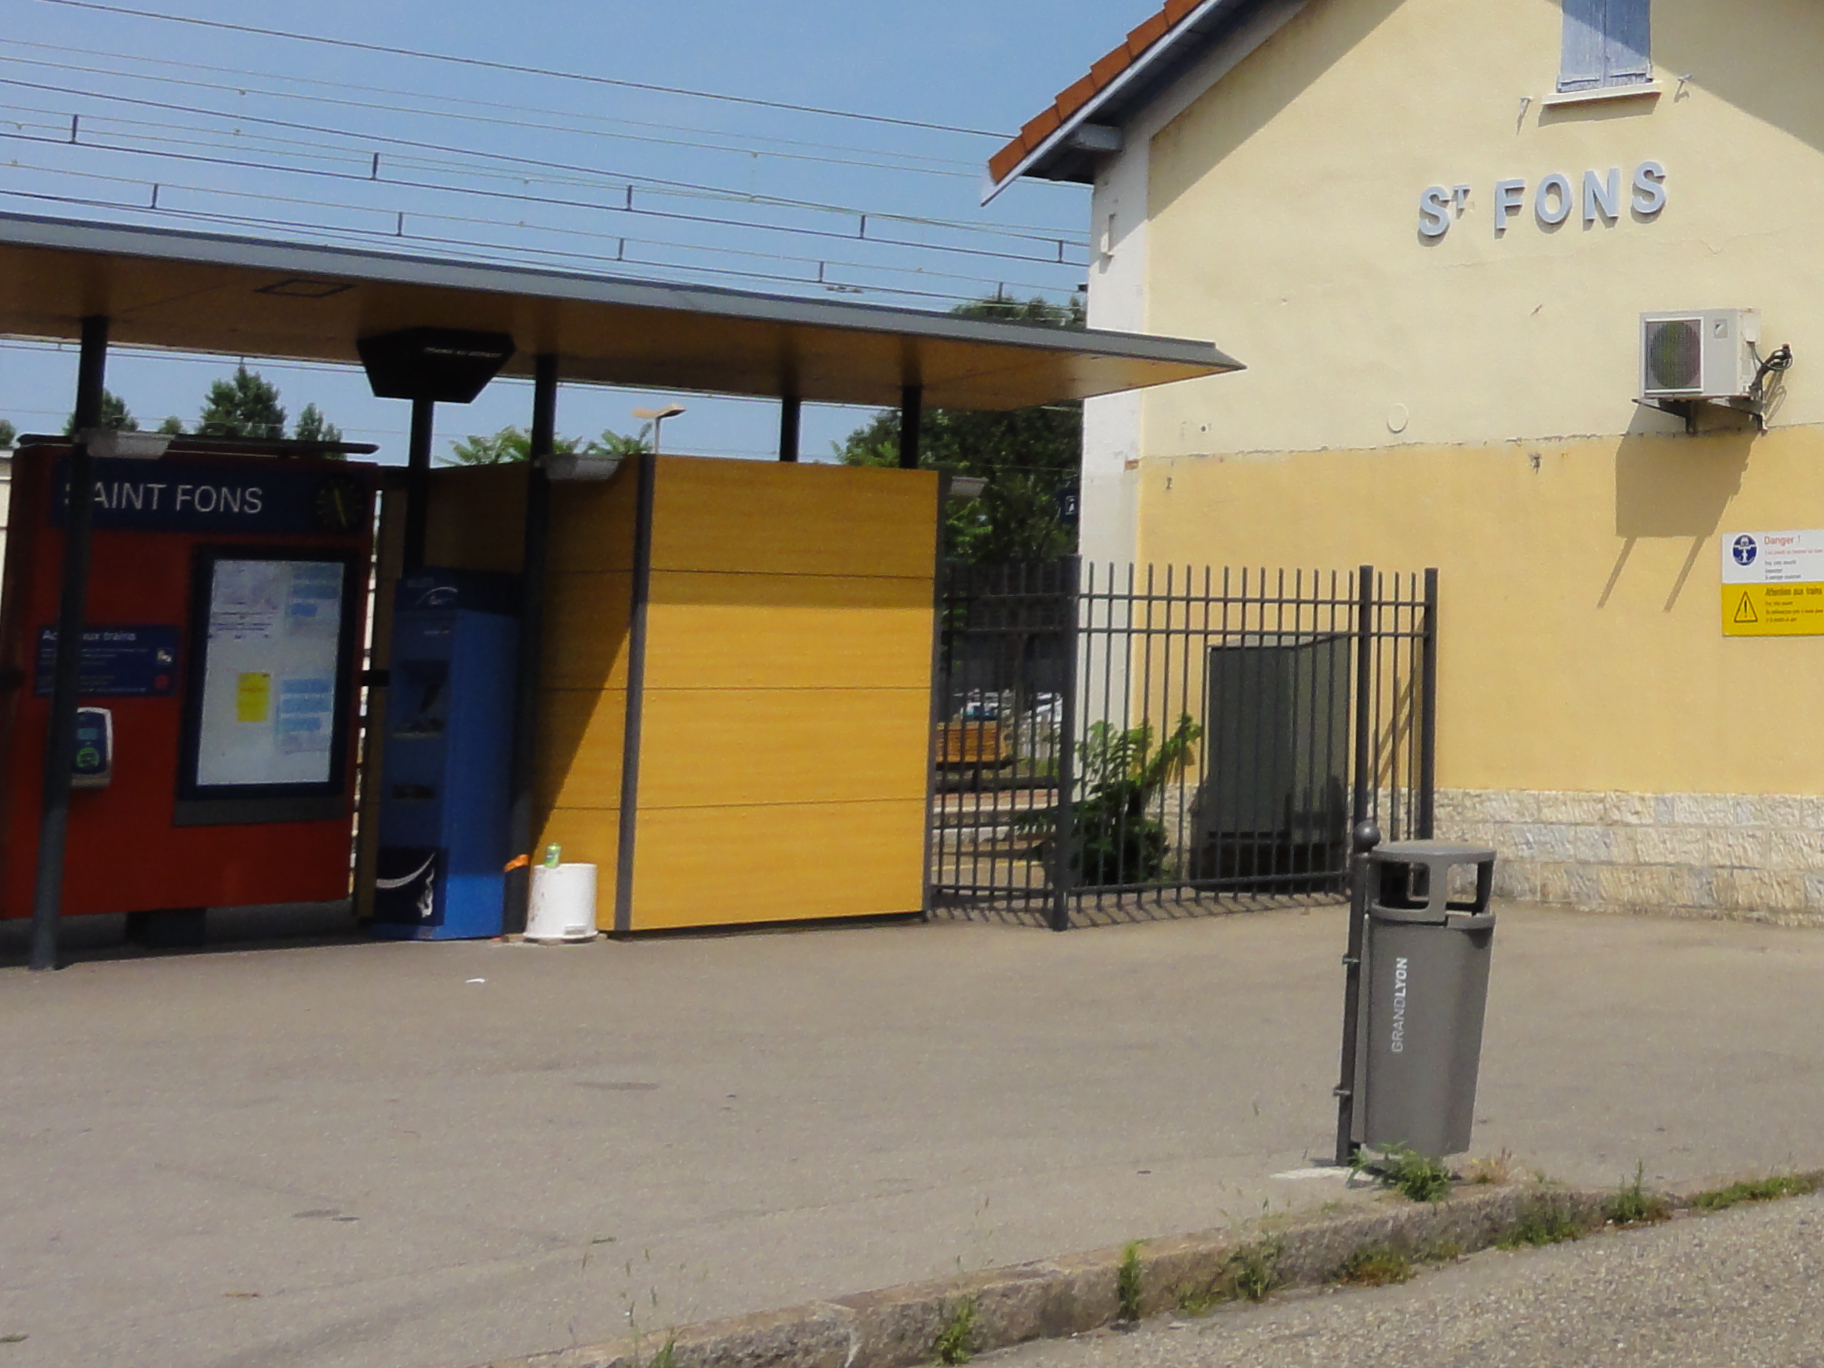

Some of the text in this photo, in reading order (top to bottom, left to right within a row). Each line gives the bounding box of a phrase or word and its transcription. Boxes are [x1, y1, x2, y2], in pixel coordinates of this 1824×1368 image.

[1494, 160, 1667, 232] FONS
[65, 482, 263, 513] AINT FONS
[1764, 536, 1794, 547] Danger
